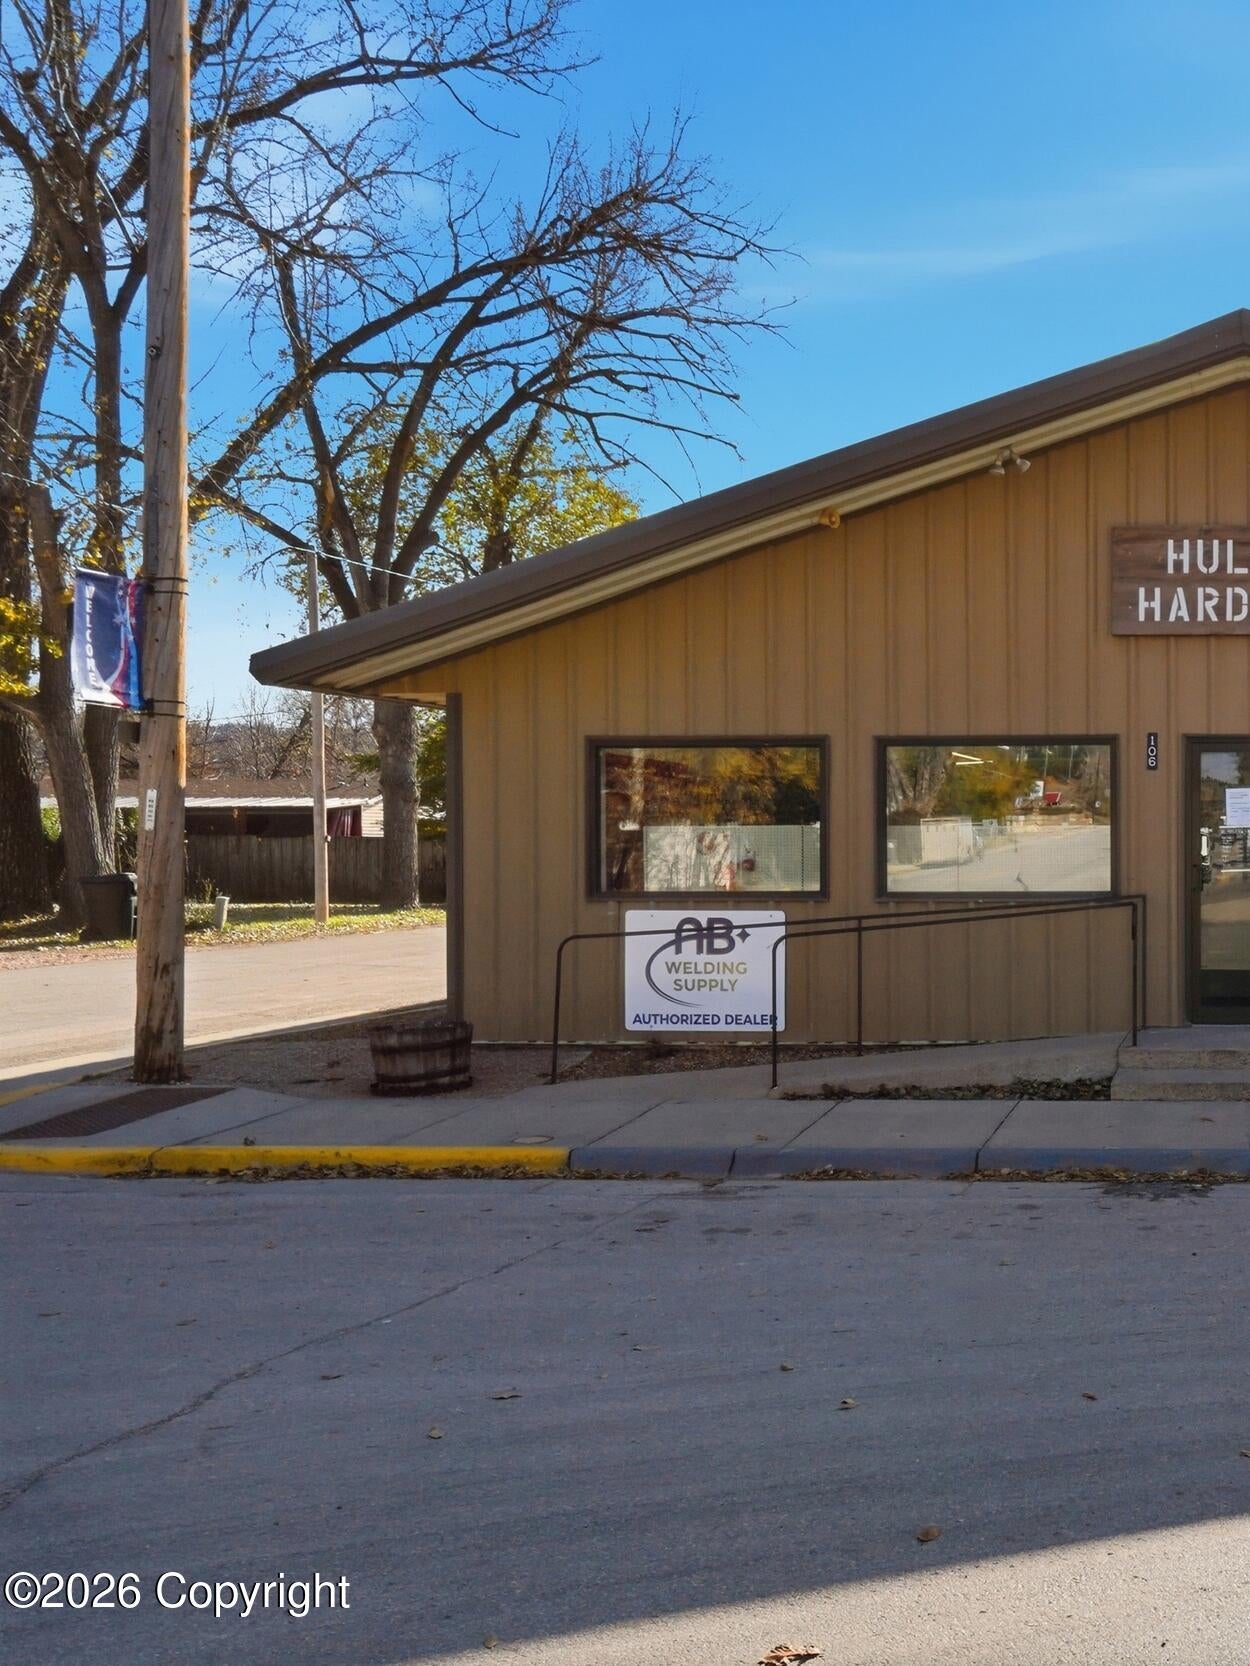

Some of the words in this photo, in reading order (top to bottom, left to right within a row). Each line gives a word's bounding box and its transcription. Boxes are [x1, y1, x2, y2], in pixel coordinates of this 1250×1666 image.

[84, 583, 98, 688] WELCOME
[1147, 735, 1157, 768] 106
[674, 917, 736, 955] AB
[665, 961, 748, 975] WELDING
[673, 978, 739, 992] SUPPLY
[632, 1013, 721, 1026] AUTHORIZED
